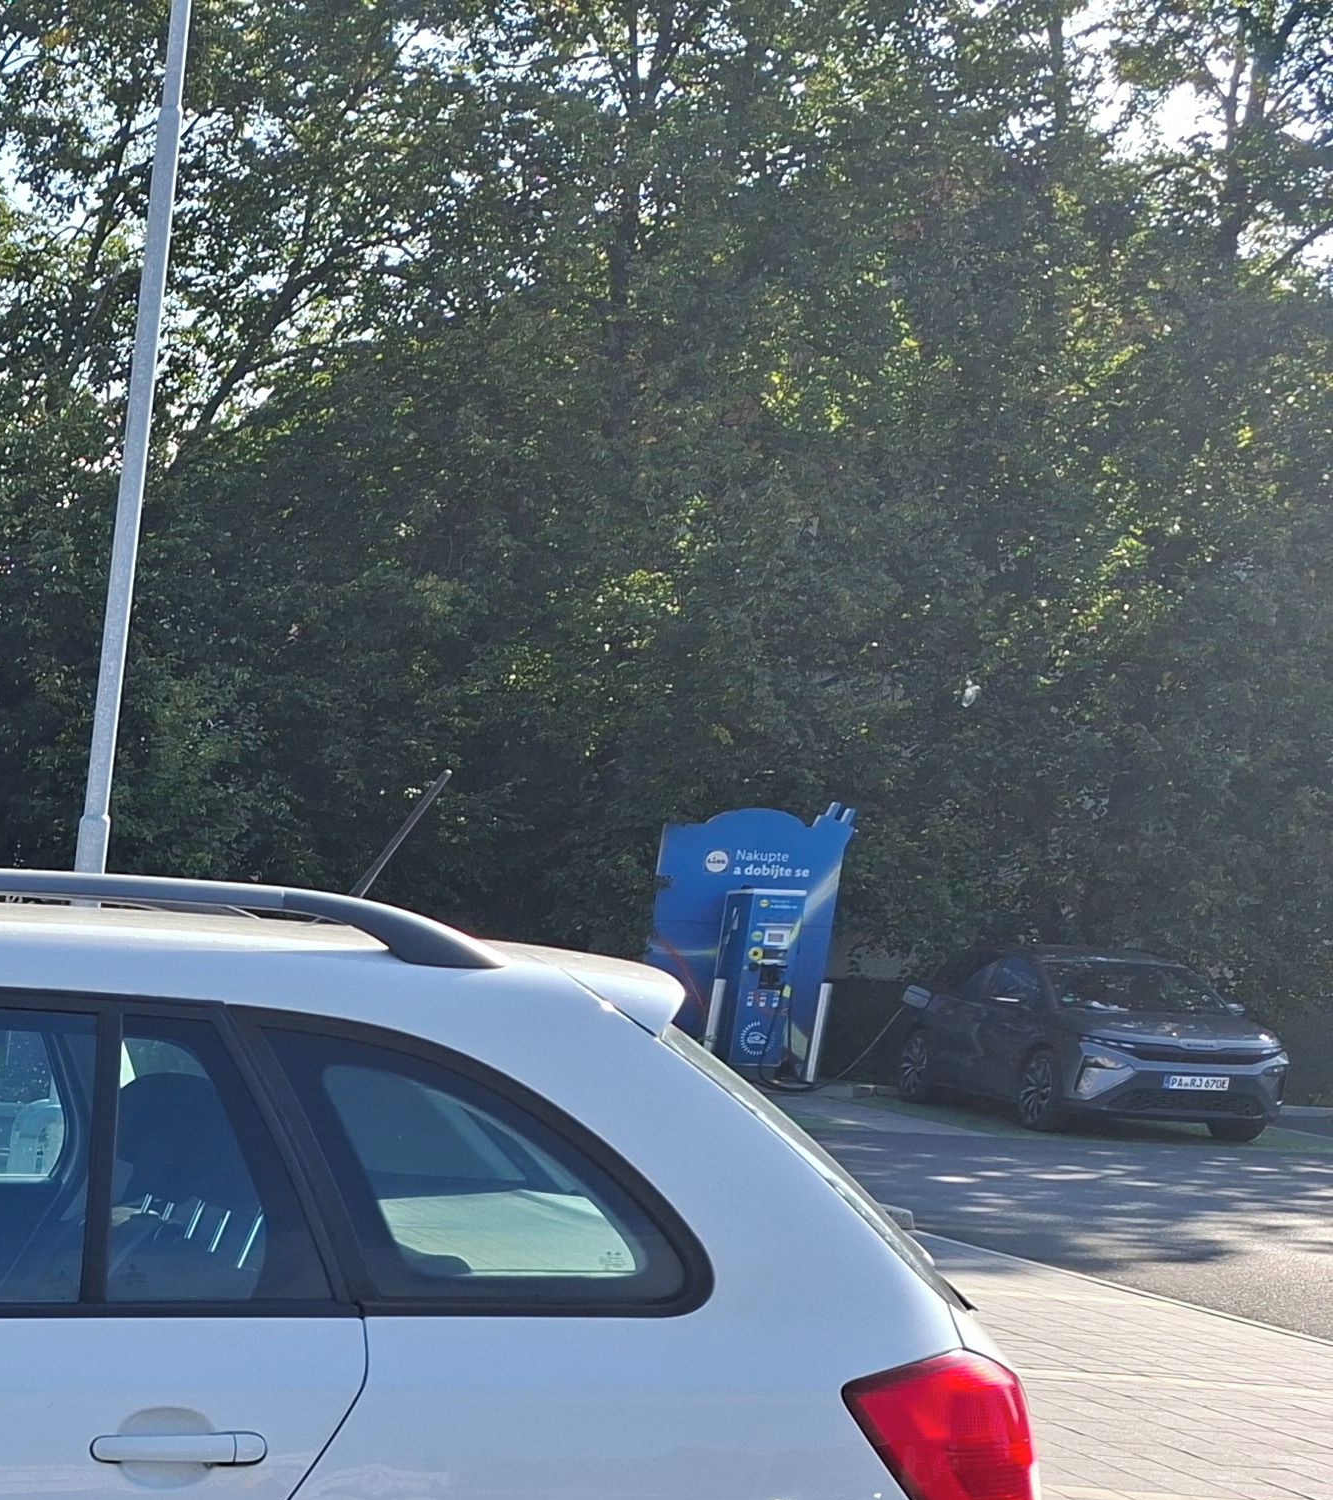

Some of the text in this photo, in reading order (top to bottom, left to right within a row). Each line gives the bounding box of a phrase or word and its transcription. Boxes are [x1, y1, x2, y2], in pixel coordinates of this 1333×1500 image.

[736, 849, 789, 864] Nakupte
[733, 864, 810, 879] a dobijte se
